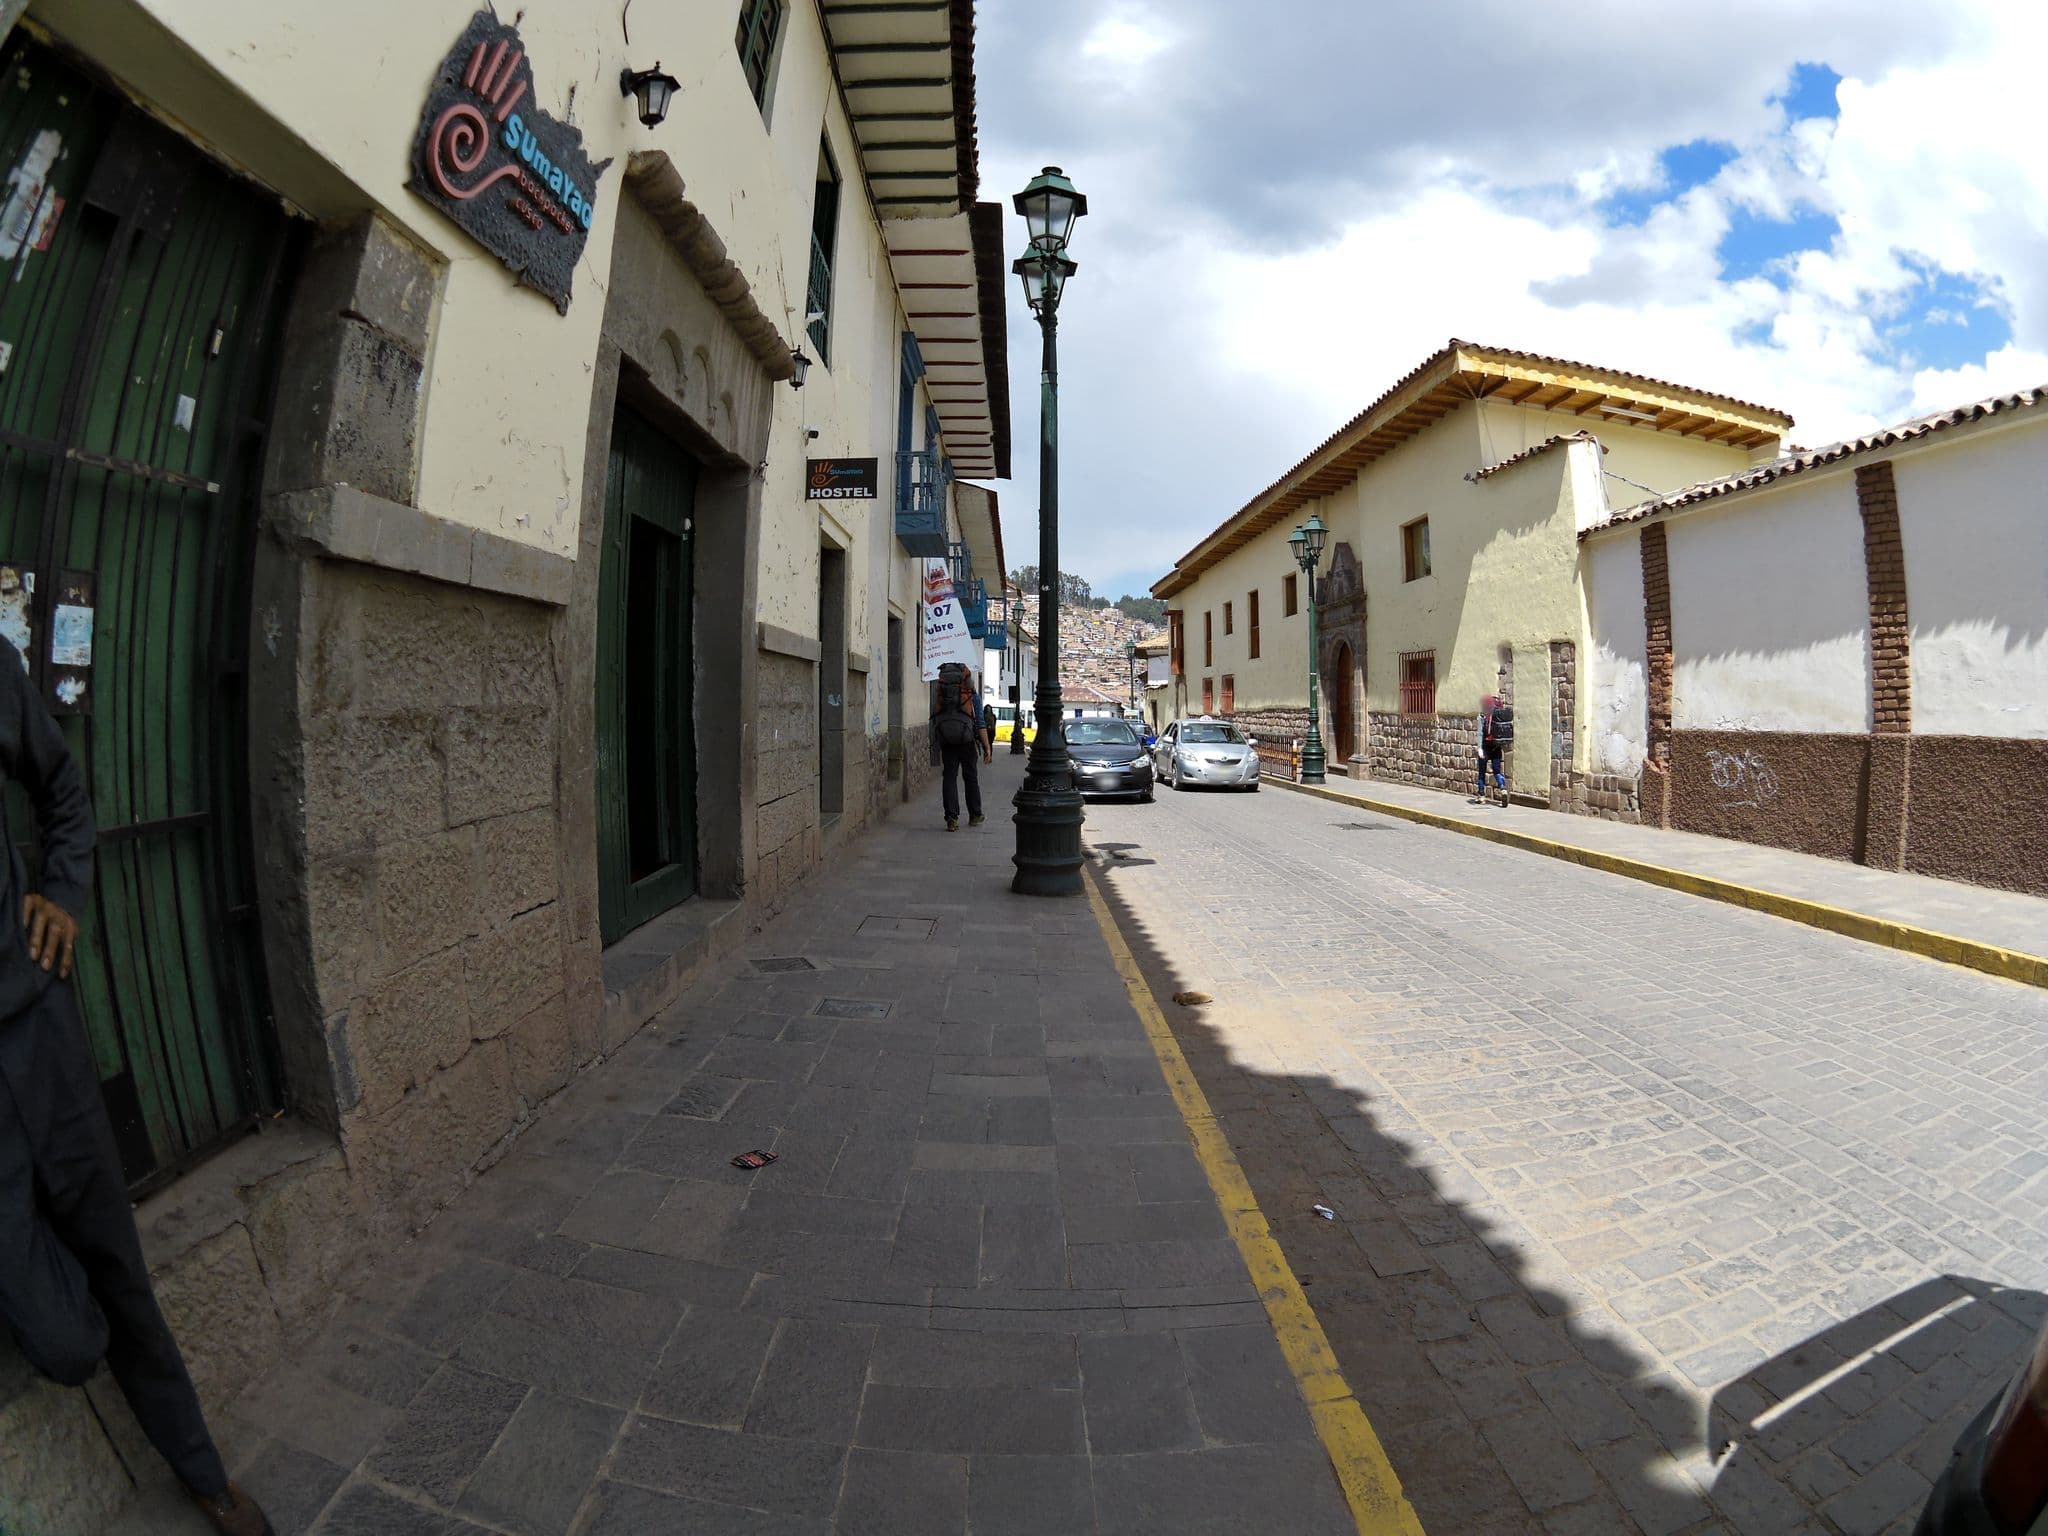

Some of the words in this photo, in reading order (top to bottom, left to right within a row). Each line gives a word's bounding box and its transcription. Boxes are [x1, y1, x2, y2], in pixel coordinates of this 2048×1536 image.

[809, 487, 873, 498] HOSTEL
[933, 603, 951, 617] 07
[926, 622, 954, 635] ubre
